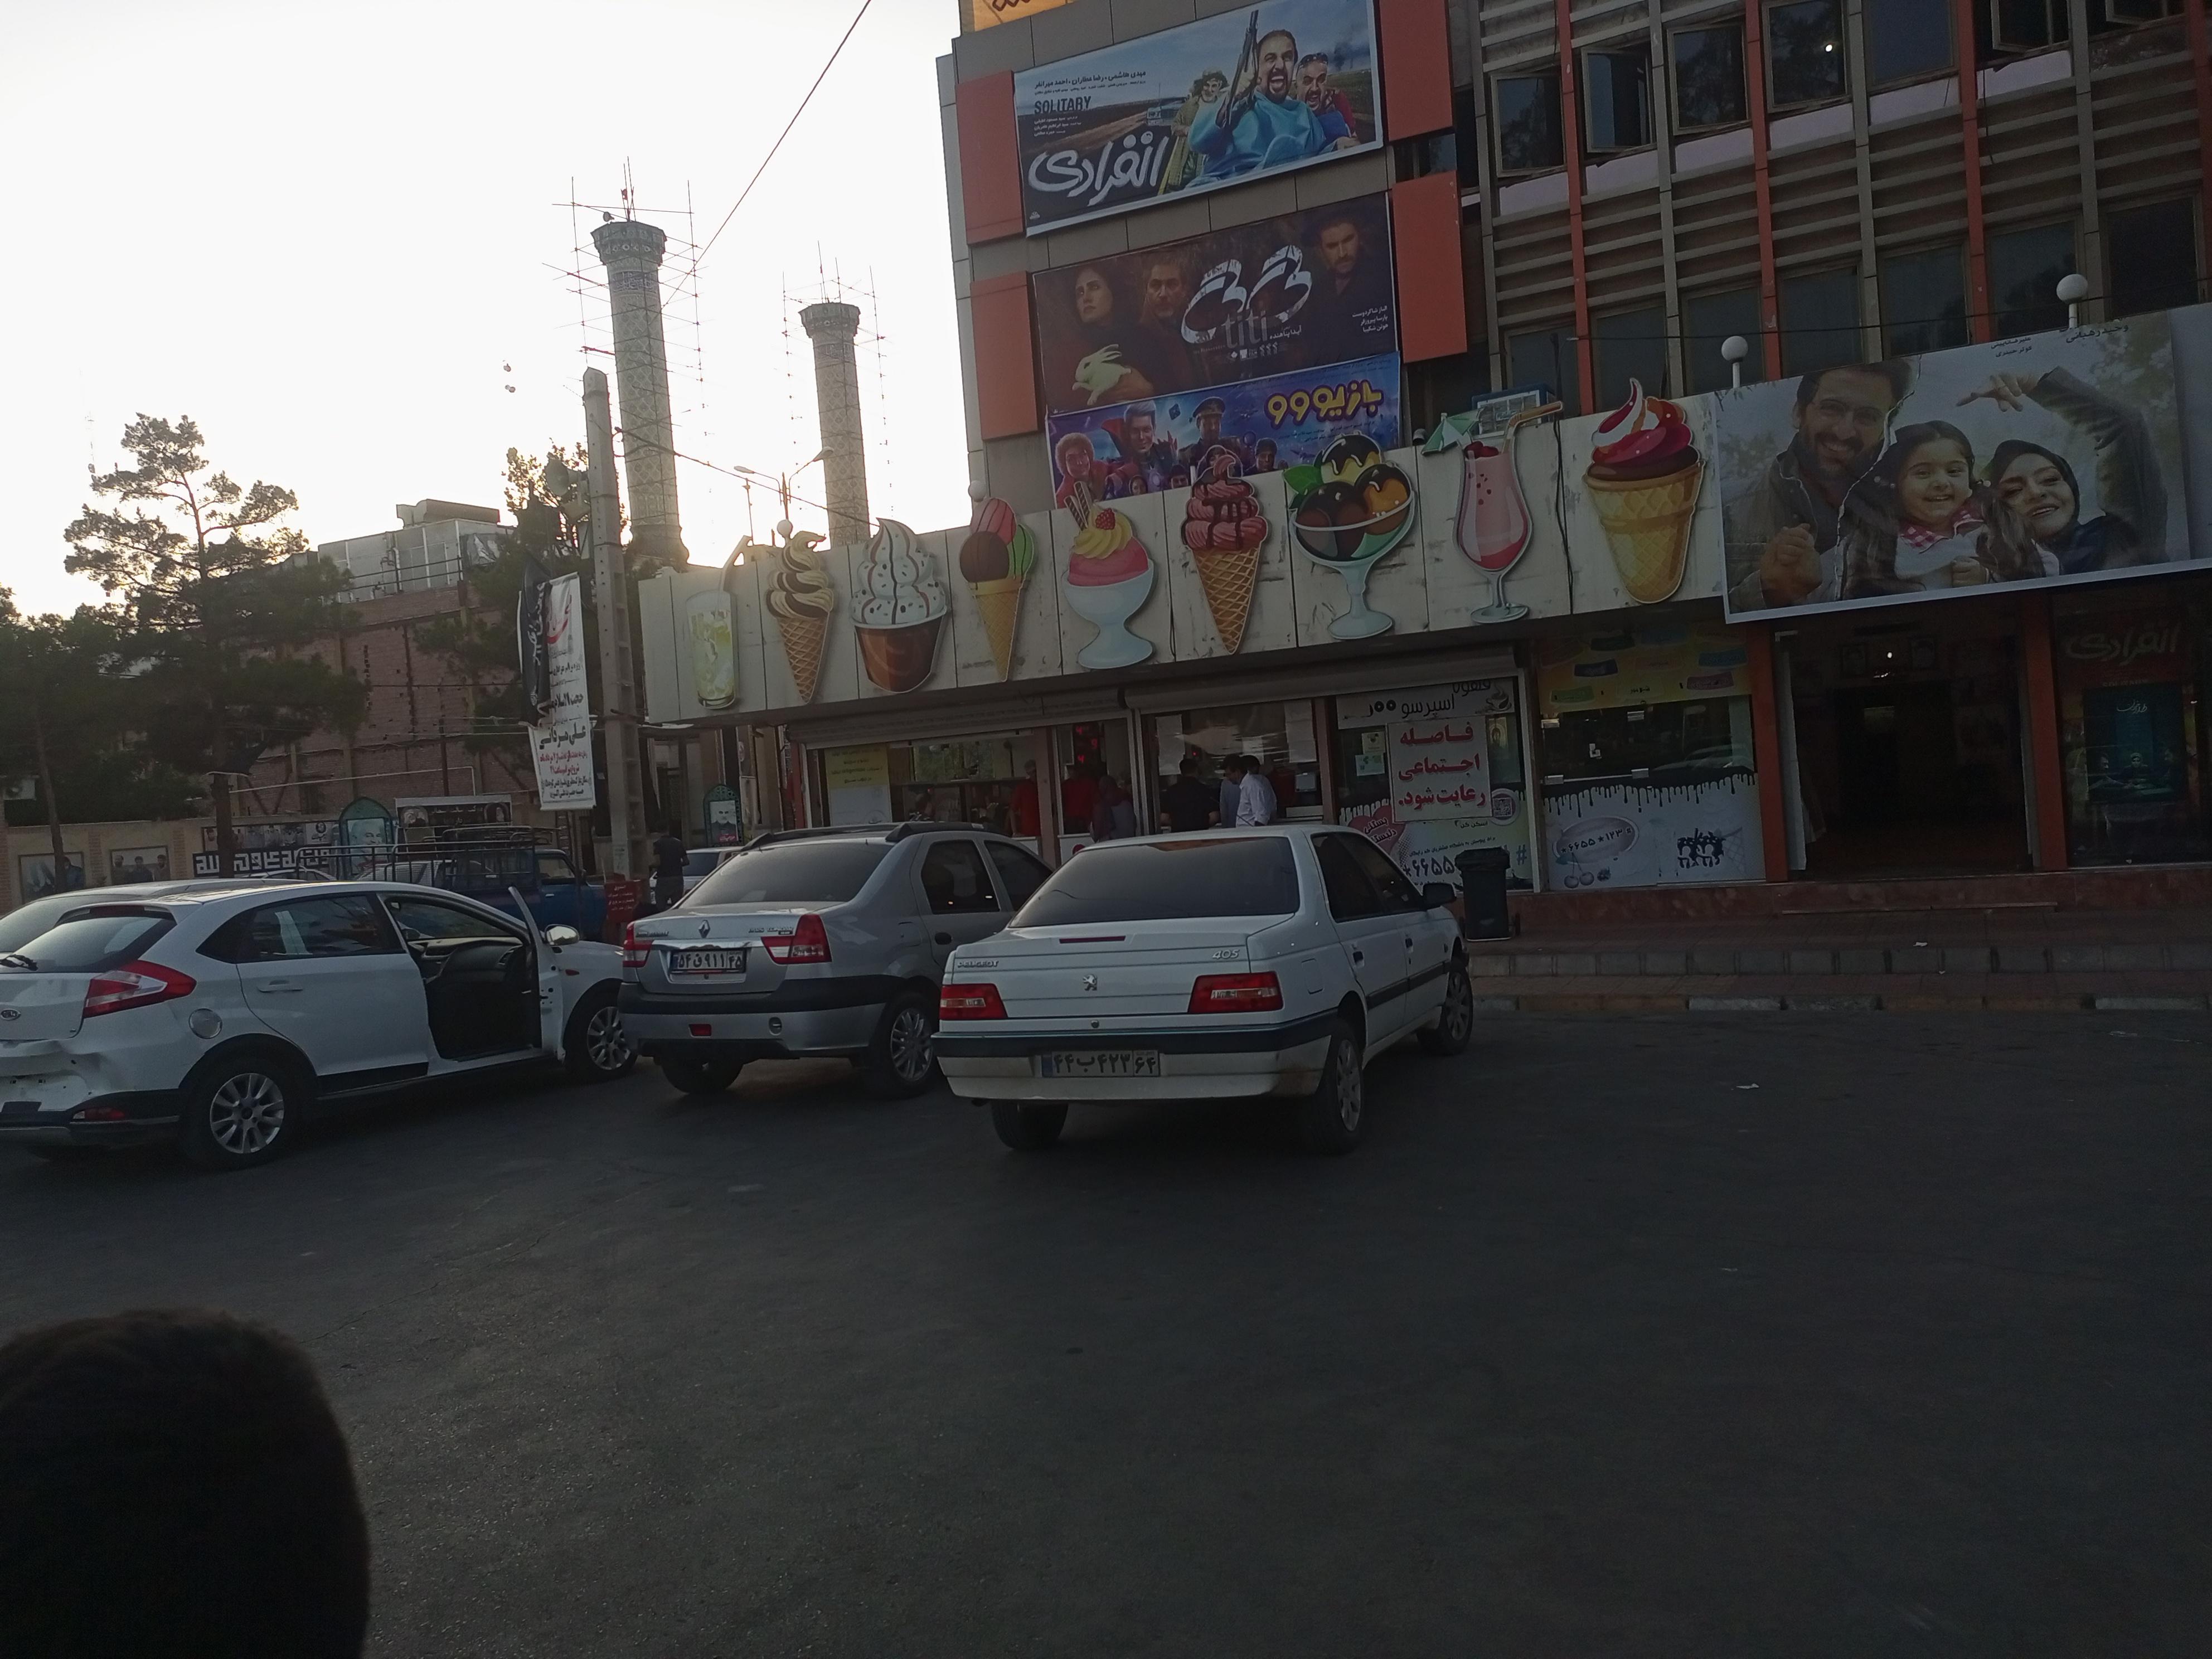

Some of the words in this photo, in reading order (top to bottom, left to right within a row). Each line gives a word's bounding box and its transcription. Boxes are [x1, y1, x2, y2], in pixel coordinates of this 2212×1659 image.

[1071, 76, 1093, 85] عطاران
[1108, 71, 1129, 82] هاشمی
[1034, 95, 1092, 115] SOLITARY
[1028, 130, 1170, 207] انفرادی
[1401, 694, 1455, 719] اسپرسو
[1400, 721, 1473, 745] فاصله
[1398, 753, 1480, 781] اجتماعی
[1398, 787, 1434, 810] شود.
[1437, 784, 1486, 807] رعایت
[1364, 817, 1388, 835] بستنی
[1371, 828, 1397, 843] دلبست
[958, 960, 999, 968] PEUGEOT
[1212, 949, 1240, 959] 405
